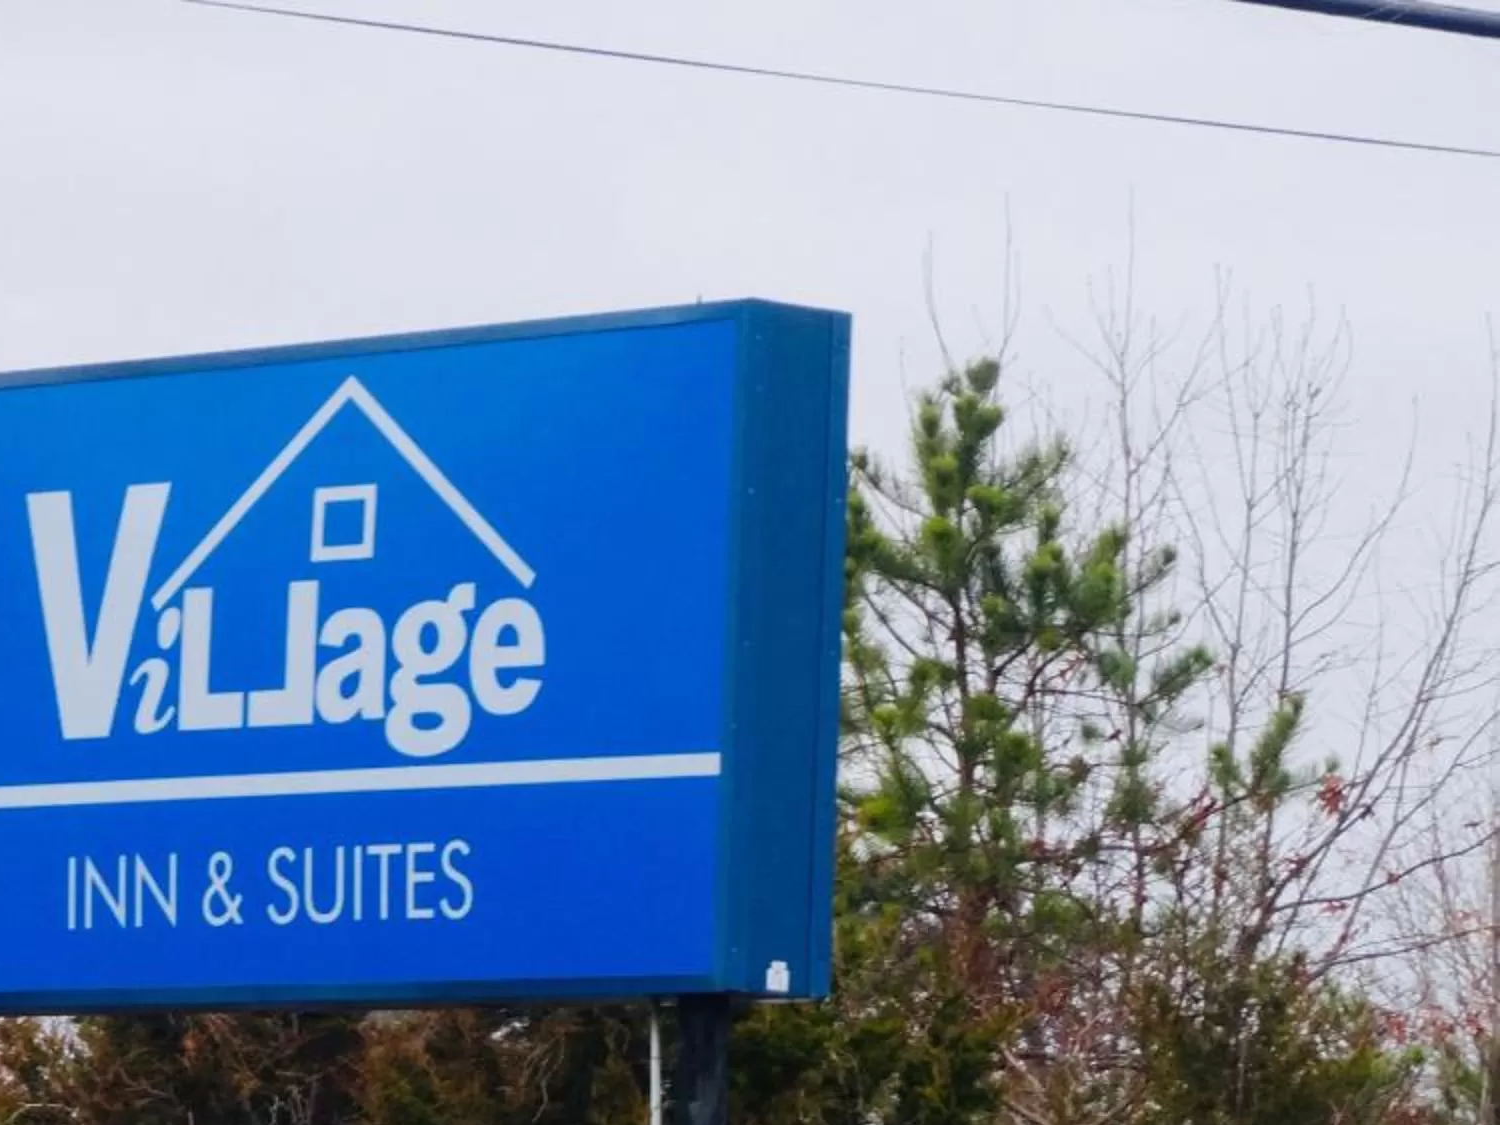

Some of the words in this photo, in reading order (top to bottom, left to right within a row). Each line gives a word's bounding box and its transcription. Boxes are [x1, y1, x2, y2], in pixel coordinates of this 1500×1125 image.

[67, 851, 178, 930] INN
[201, 849, 243, 926] &
[266, 838, 473, 925] SUITES
